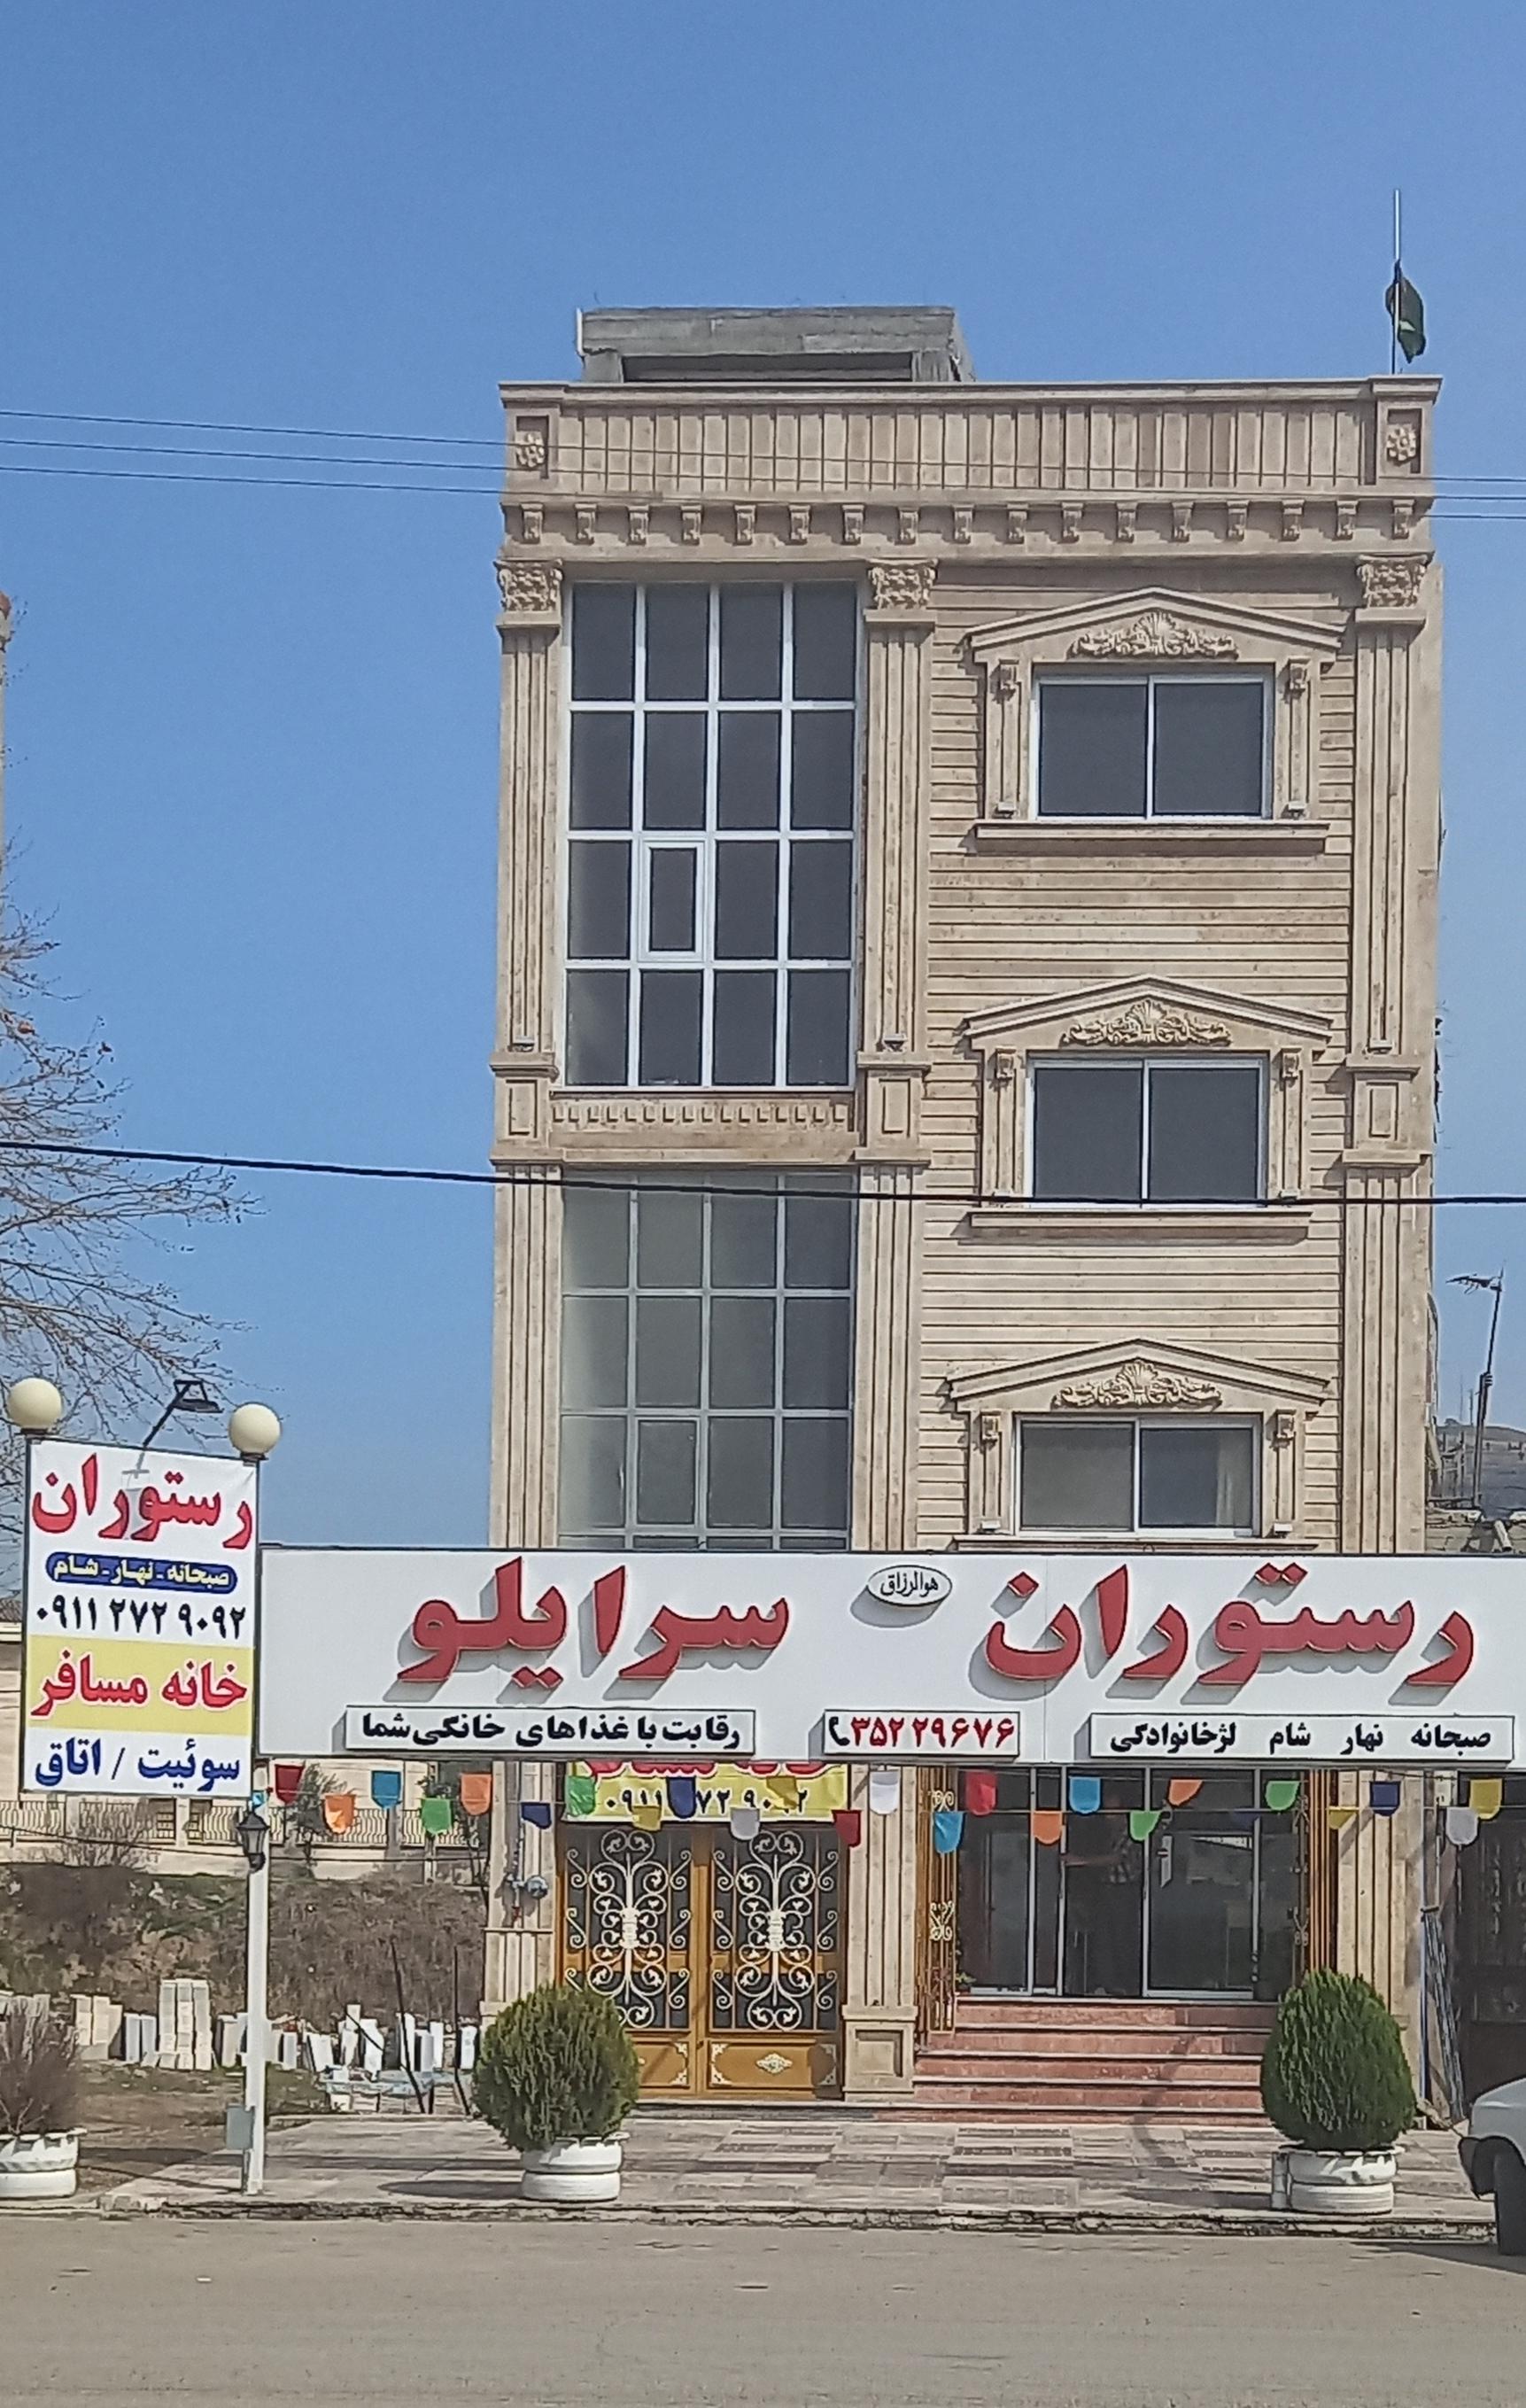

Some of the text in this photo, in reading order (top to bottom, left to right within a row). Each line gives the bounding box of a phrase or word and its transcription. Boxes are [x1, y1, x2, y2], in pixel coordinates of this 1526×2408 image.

[32, 1453, 253, 1550] رستوران
[54, 1555, 99, 1580] شام
[110, 1559, 154, 1586] نهار
[167, 1564, 230, 1589] صبحانه
[36, 1594, 246, 1640] ۰۹۱۱ ۲۷۲ ۹۰۹۲
[397, 1556, 1476, 1689] رستوران سرایلو
[31, 1650, 248, 1717] خانه مسافر
[363, 1713, 411, 1738] شما
[515, 1713, 630, 1747] غذاهای
[638, 1715, 657, 1749] با
[662, 1714, 740, 1750] رقابت
[1269, 1721, 1312, 1756] شام
[1339, 1722, 1383, 1755] نهار
[1411, 1722, 1491, 1756] صبحانه
[35, 1736, 102, 1787] اتاق
[137, 1737, 240, 1791] سوئیت
[742, 1789, 809, 1814] ۹۰۲
